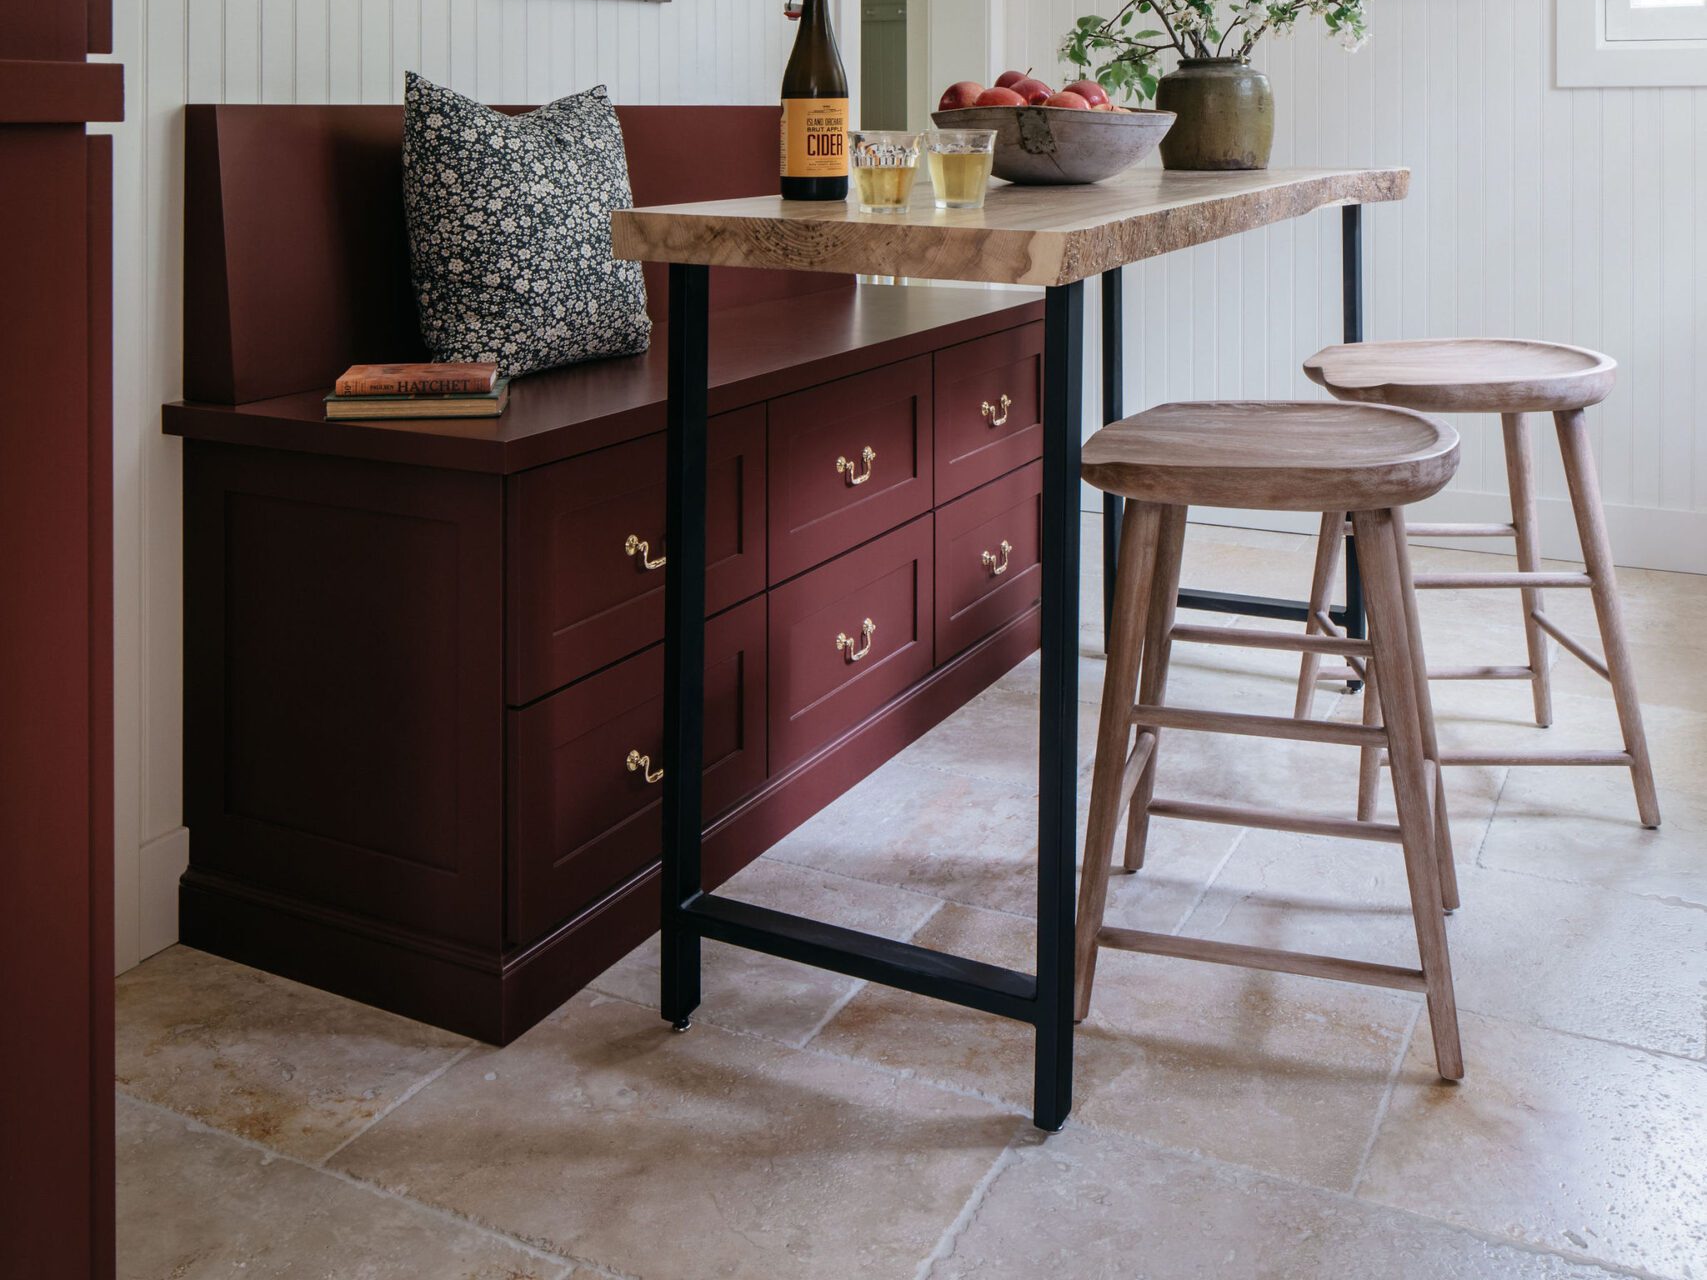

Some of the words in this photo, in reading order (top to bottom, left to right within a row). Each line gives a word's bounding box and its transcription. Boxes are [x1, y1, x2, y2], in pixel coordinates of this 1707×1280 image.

[806, 118, 823, 126] ISLAND
[807, 134, 843, 156] CIDER
[397, 379, 471, 393] HATCHET
